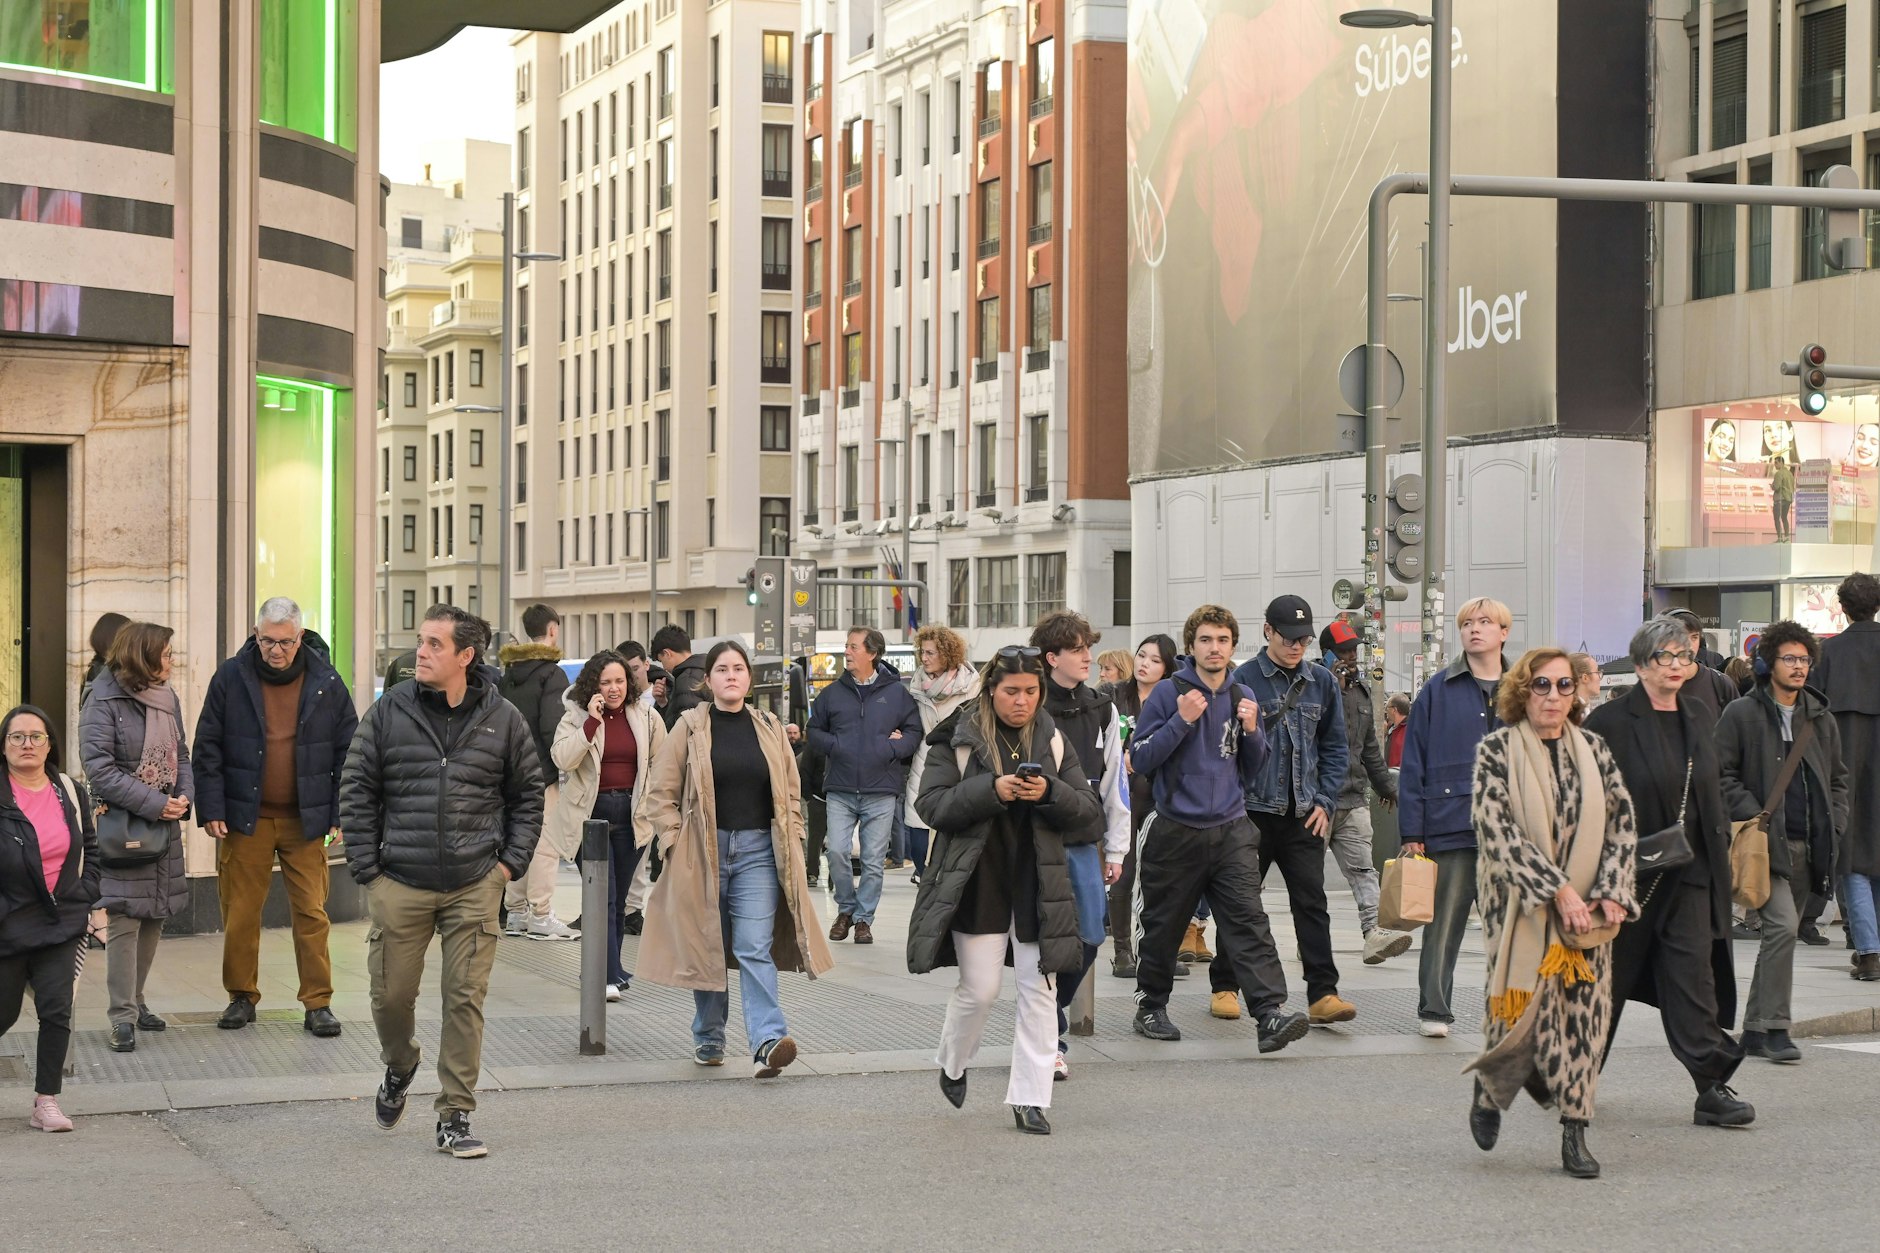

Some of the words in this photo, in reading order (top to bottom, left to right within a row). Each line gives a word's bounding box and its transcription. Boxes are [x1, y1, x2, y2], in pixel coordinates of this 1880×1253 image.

[1355, 26, 1469, 97] Súbee.
[1295, 609, 1305, 619] R
[825, 656, 836, 674] 2
